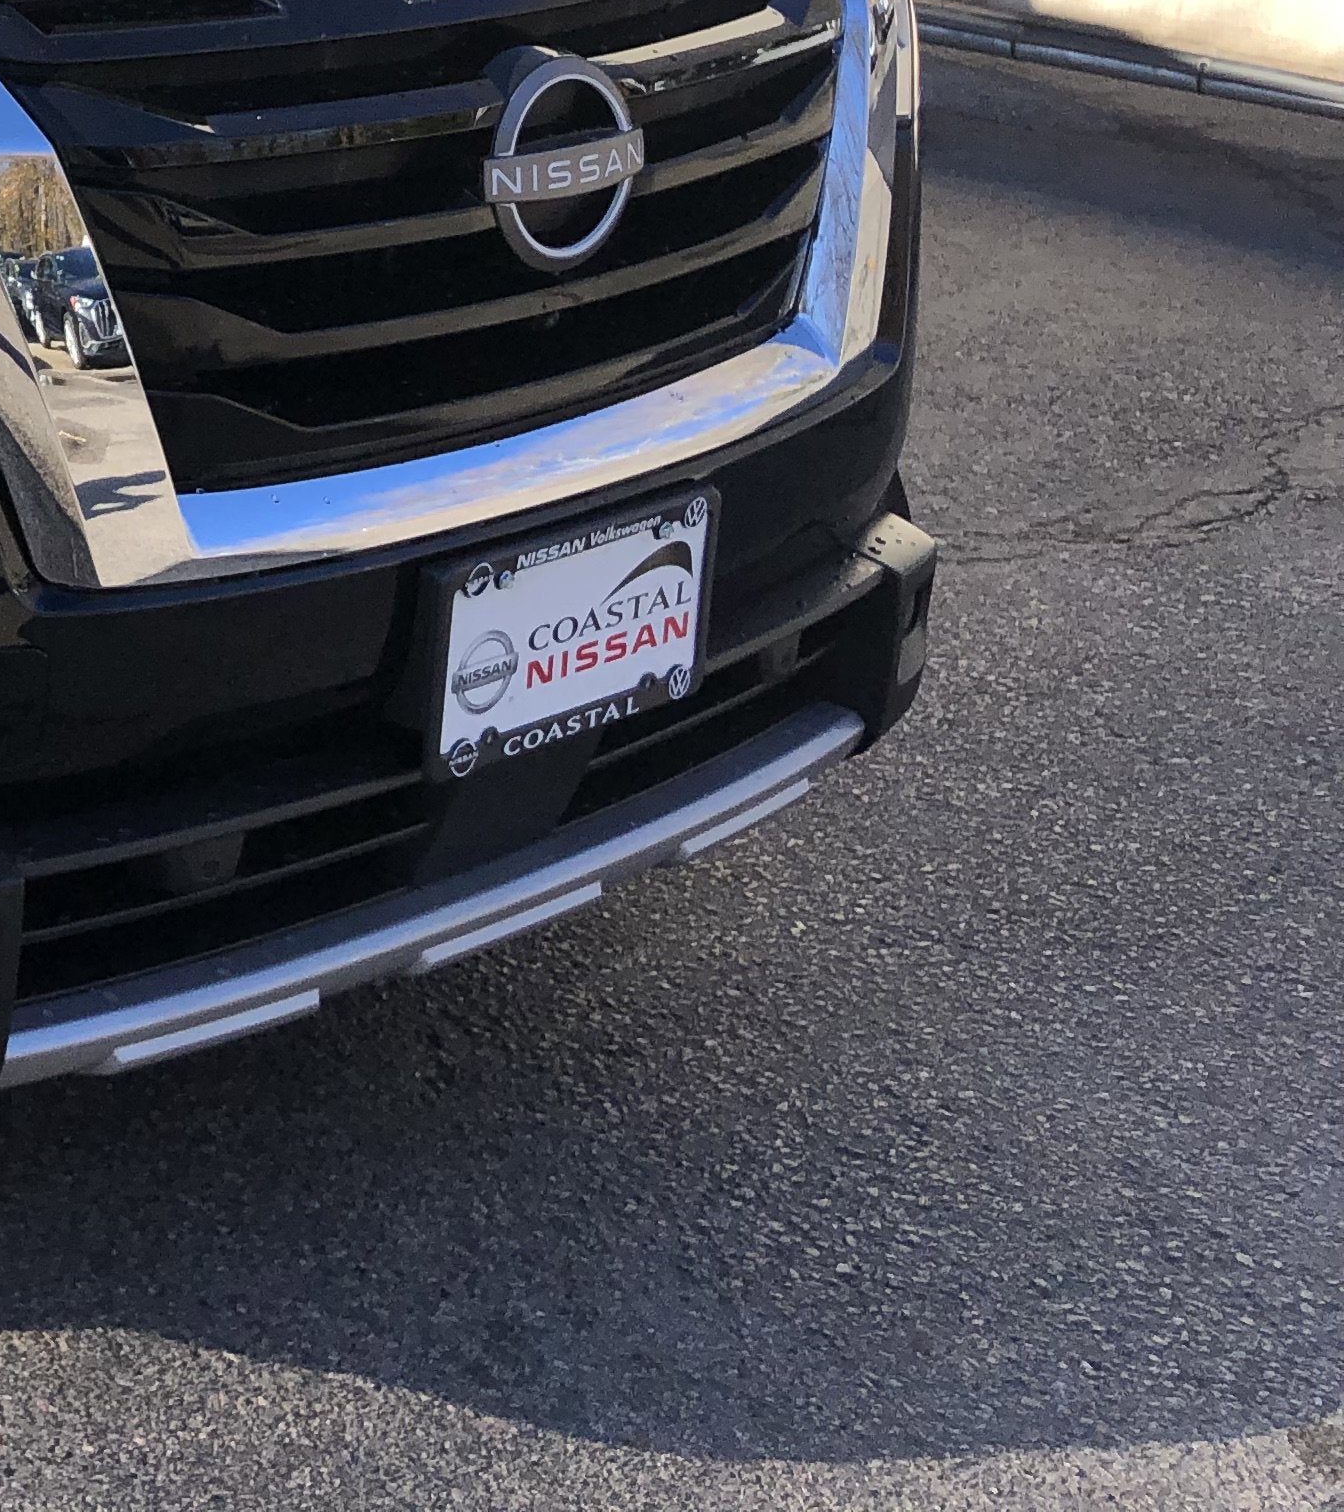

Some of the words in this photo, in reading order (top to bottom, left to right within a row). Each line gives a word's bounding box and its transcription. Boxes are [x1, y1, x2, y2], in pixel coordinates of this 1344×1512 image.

[491, 137, 642, 196] NISSAN
[516, 536, 586, 570] NISSAN
[589, 515, 662, 548] Volkswagen
[528, 580, 692, 651] COASTAL
[457, 659, 513, 686] NISSAN
[526, 611, 689, 689] NISSAN
[503, 696, 640, 756] COASTAL
